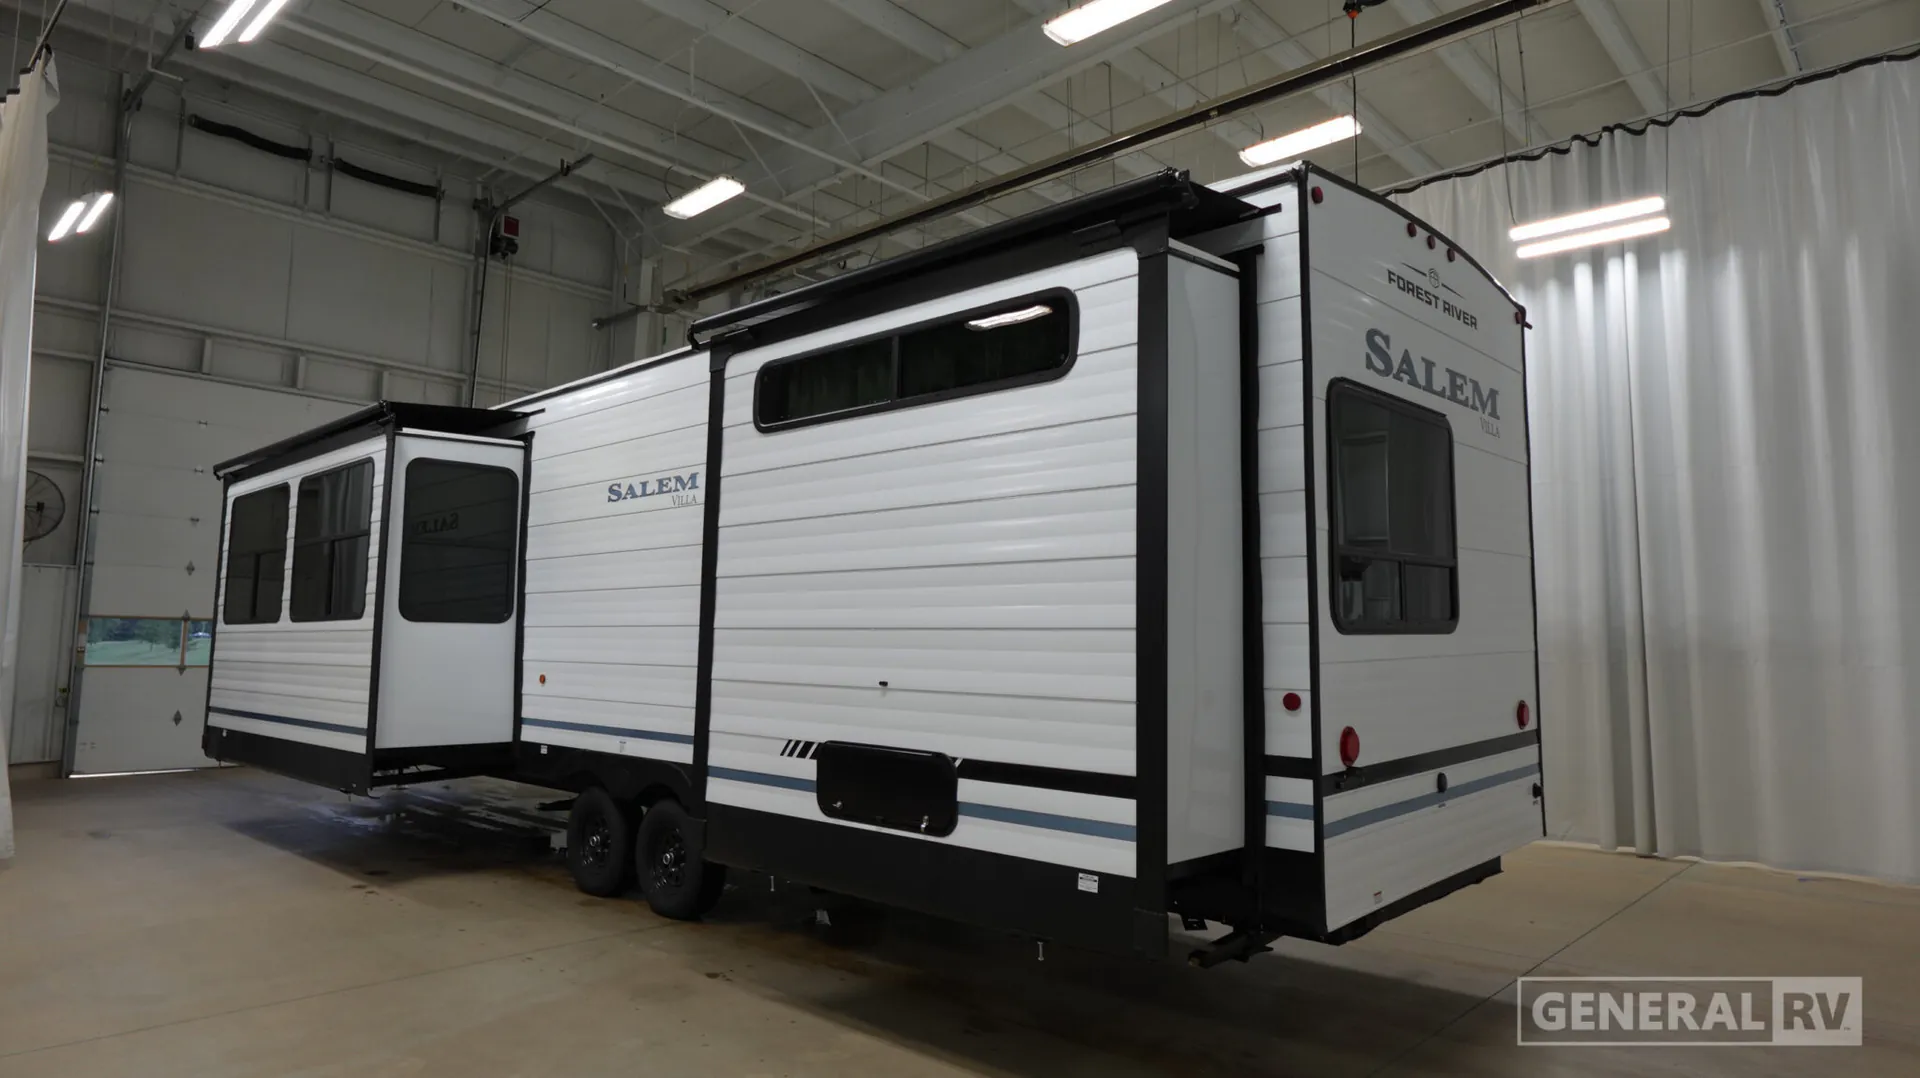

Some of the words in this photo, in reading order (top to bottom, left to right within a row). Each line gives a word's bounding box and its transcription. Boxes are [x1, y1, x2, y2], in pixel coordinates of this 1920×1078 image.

[1387, 269, 1440, 309] FOREST
[1442, 299, 1478, 330] RIVER
[1365, 328, 1500, 420] SALEM
[1480, 417, 1500, 438] VILLA
[607, 472, 699, 503] SALEM
[671, 494, 697, 508] VILLA
